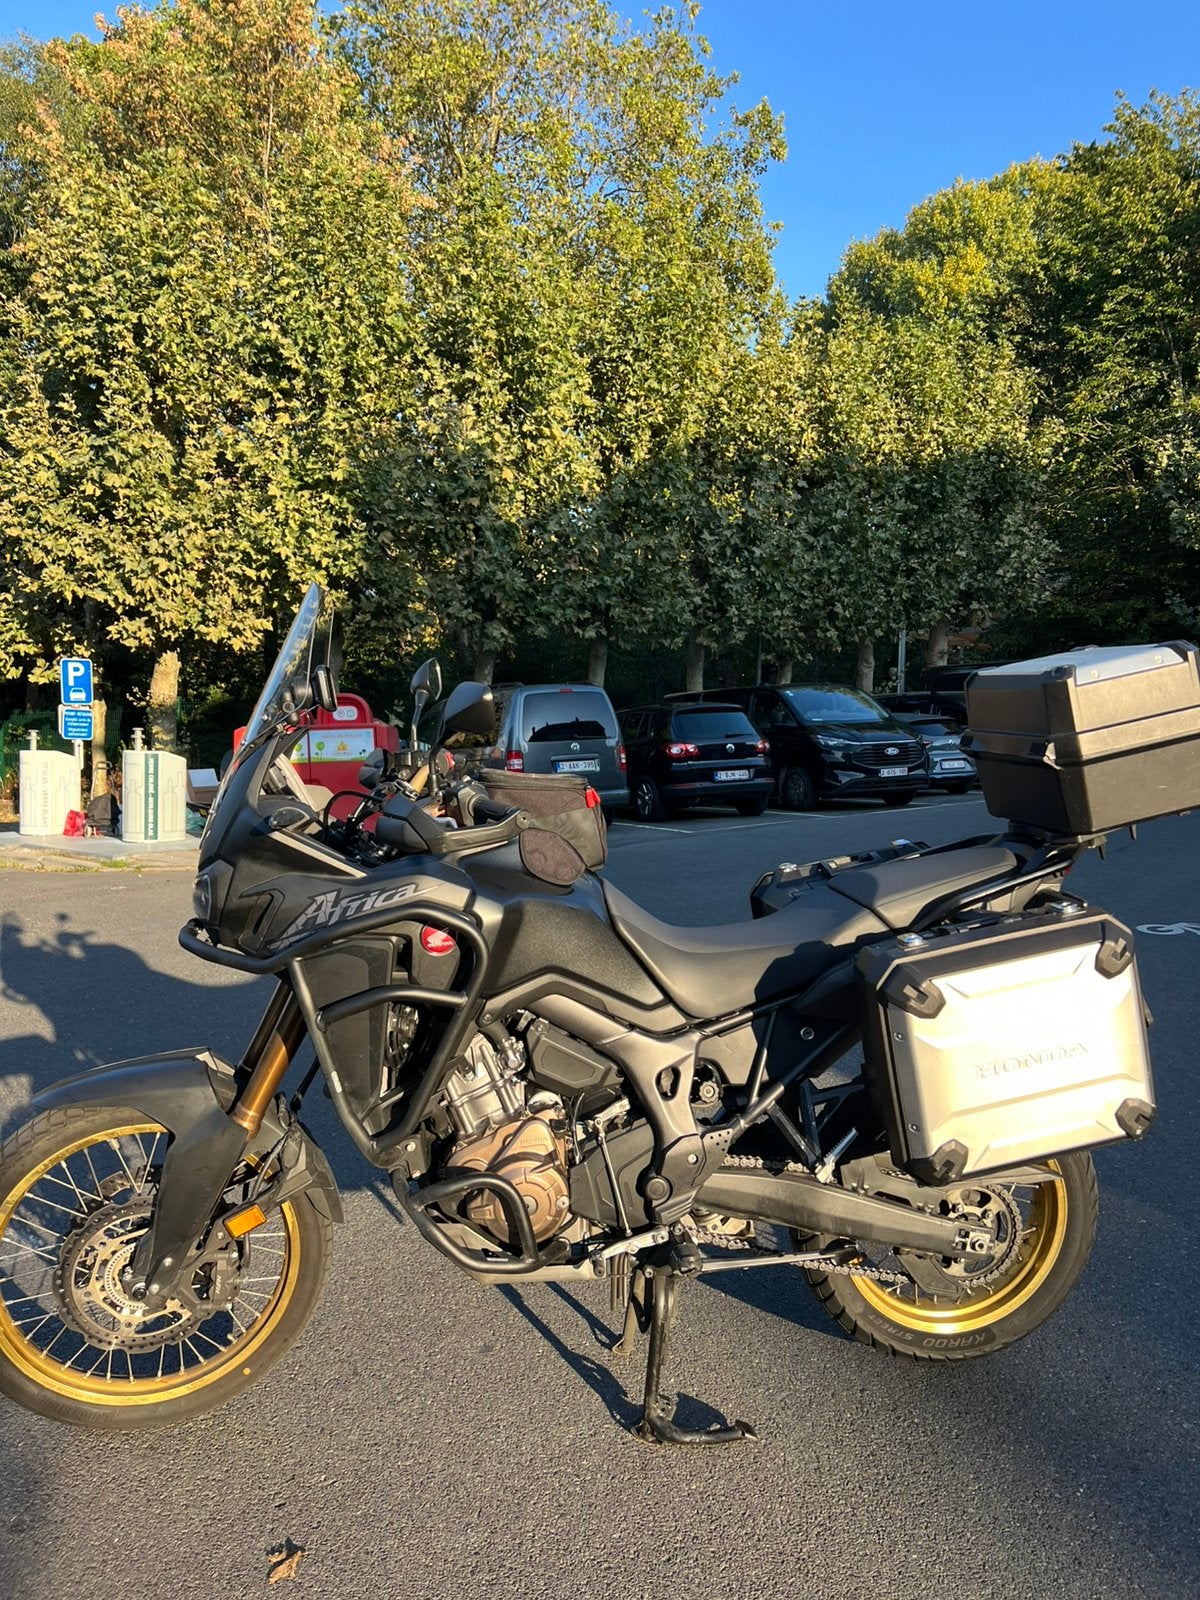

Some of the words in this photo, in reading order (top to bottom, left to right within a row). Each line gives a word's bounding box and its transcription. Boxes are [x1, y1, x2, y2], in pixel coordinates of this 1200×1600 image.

[68, 662, 85, 686] P
[276, 883, 425, 942] Africa
[975, 1042, 1089, 1080] HONDA
[922, 1332, 986, 1348] KAROO
